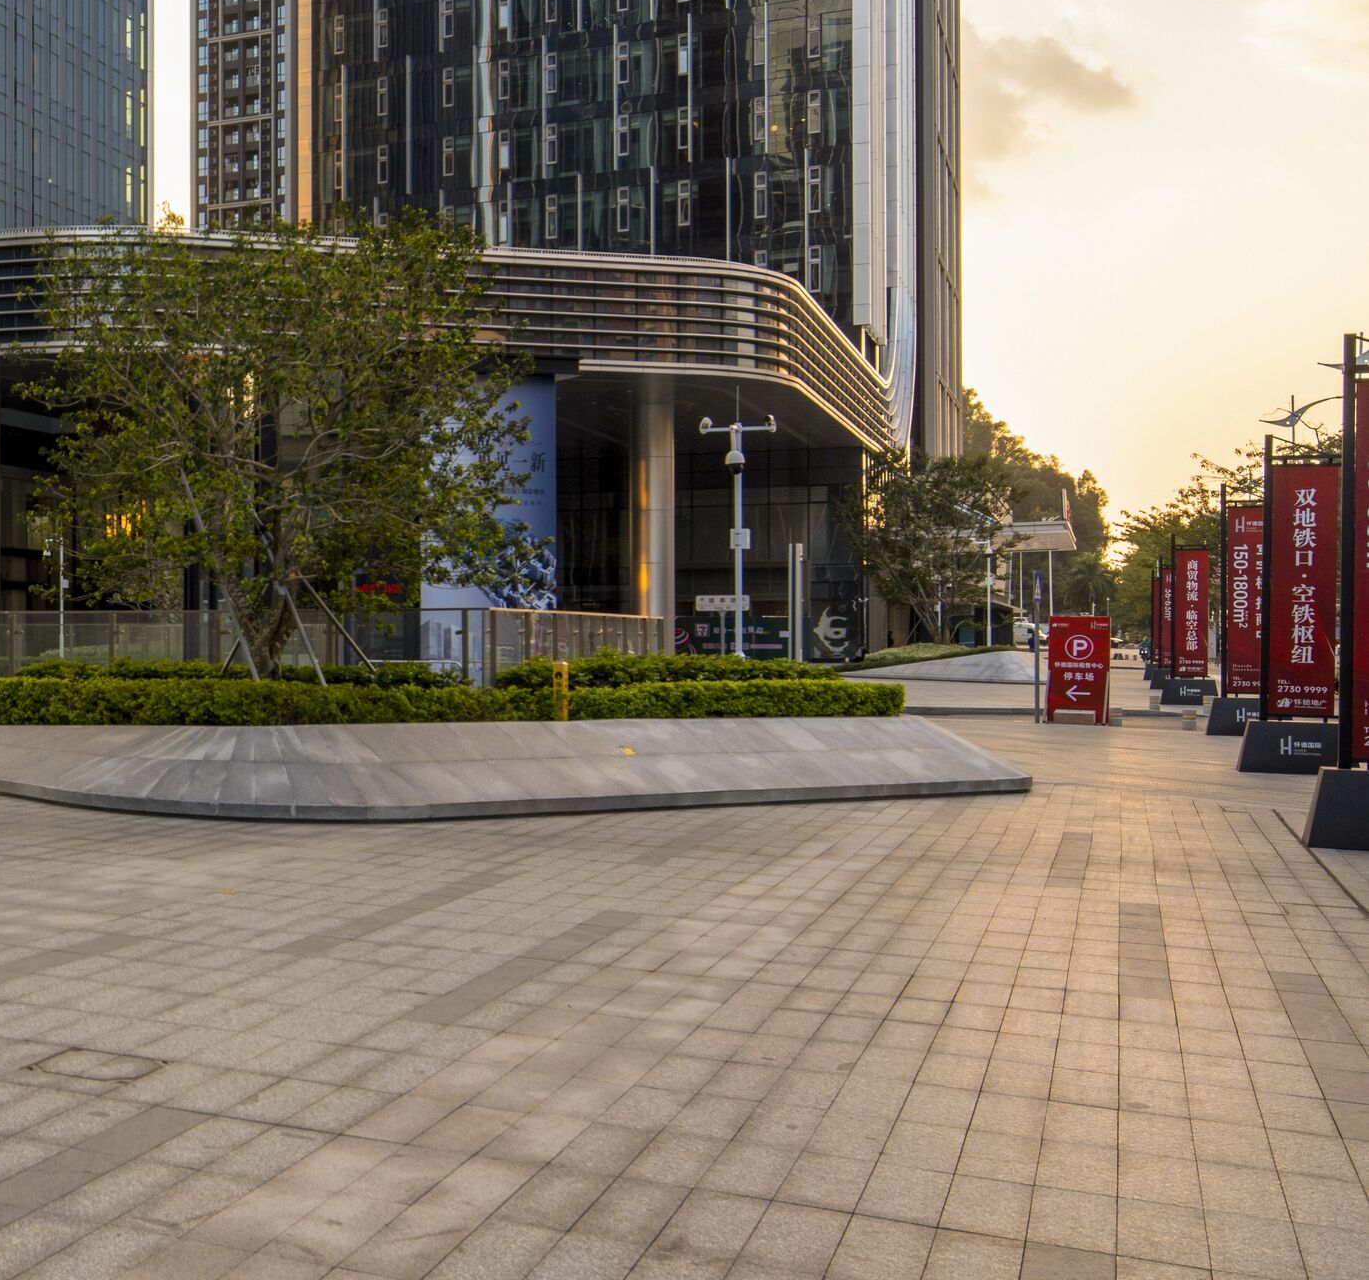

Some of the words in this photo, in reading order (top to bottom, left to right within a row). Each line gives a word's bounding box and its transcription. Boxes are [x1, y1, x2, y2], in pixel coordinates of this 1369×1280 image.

[1291, 488, 1317, 664] 双地铁口·空铁枢纽
[1073, 640, 1087, 656] P
[1064, 672, 1094, 681] 停车场
